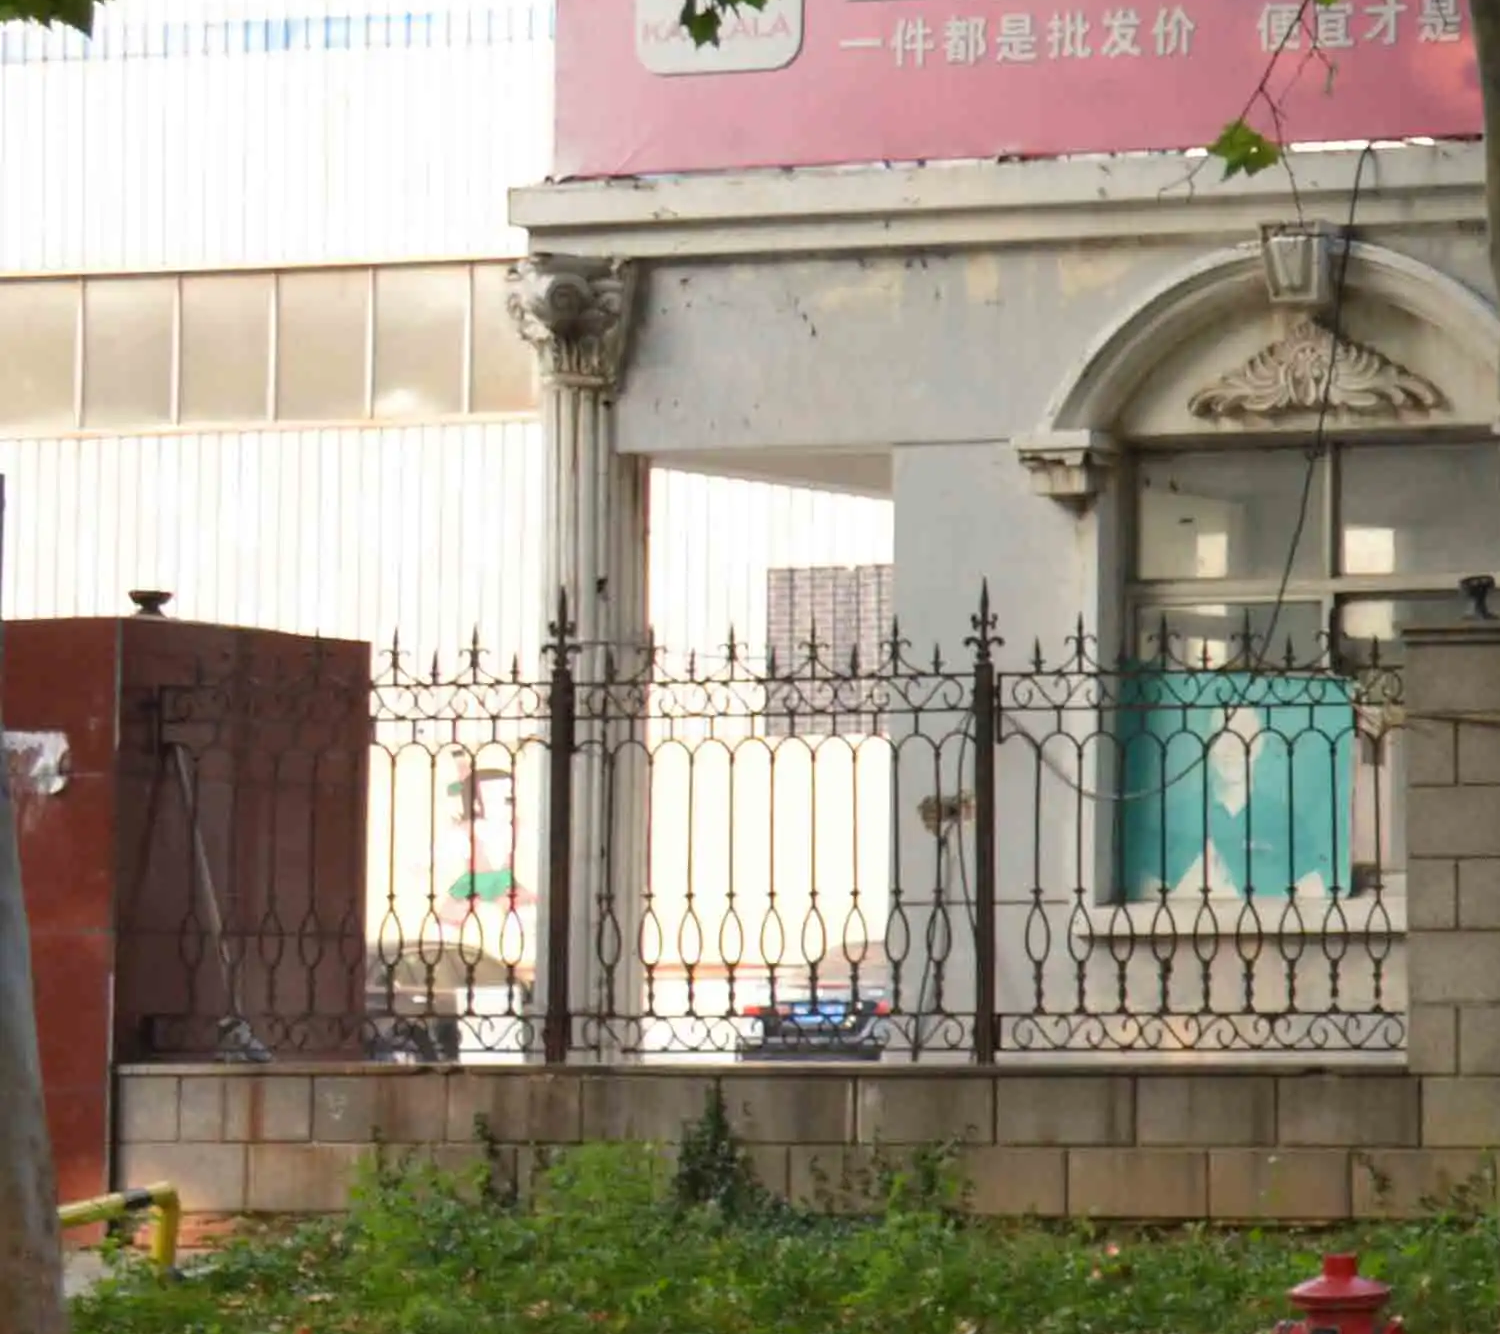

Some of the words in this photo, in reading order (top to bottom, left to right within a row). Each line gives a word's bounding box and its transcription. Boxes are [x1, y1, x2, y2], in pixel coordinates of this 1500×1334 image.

[839, 5, 1196, 68] 一件都是批发价
